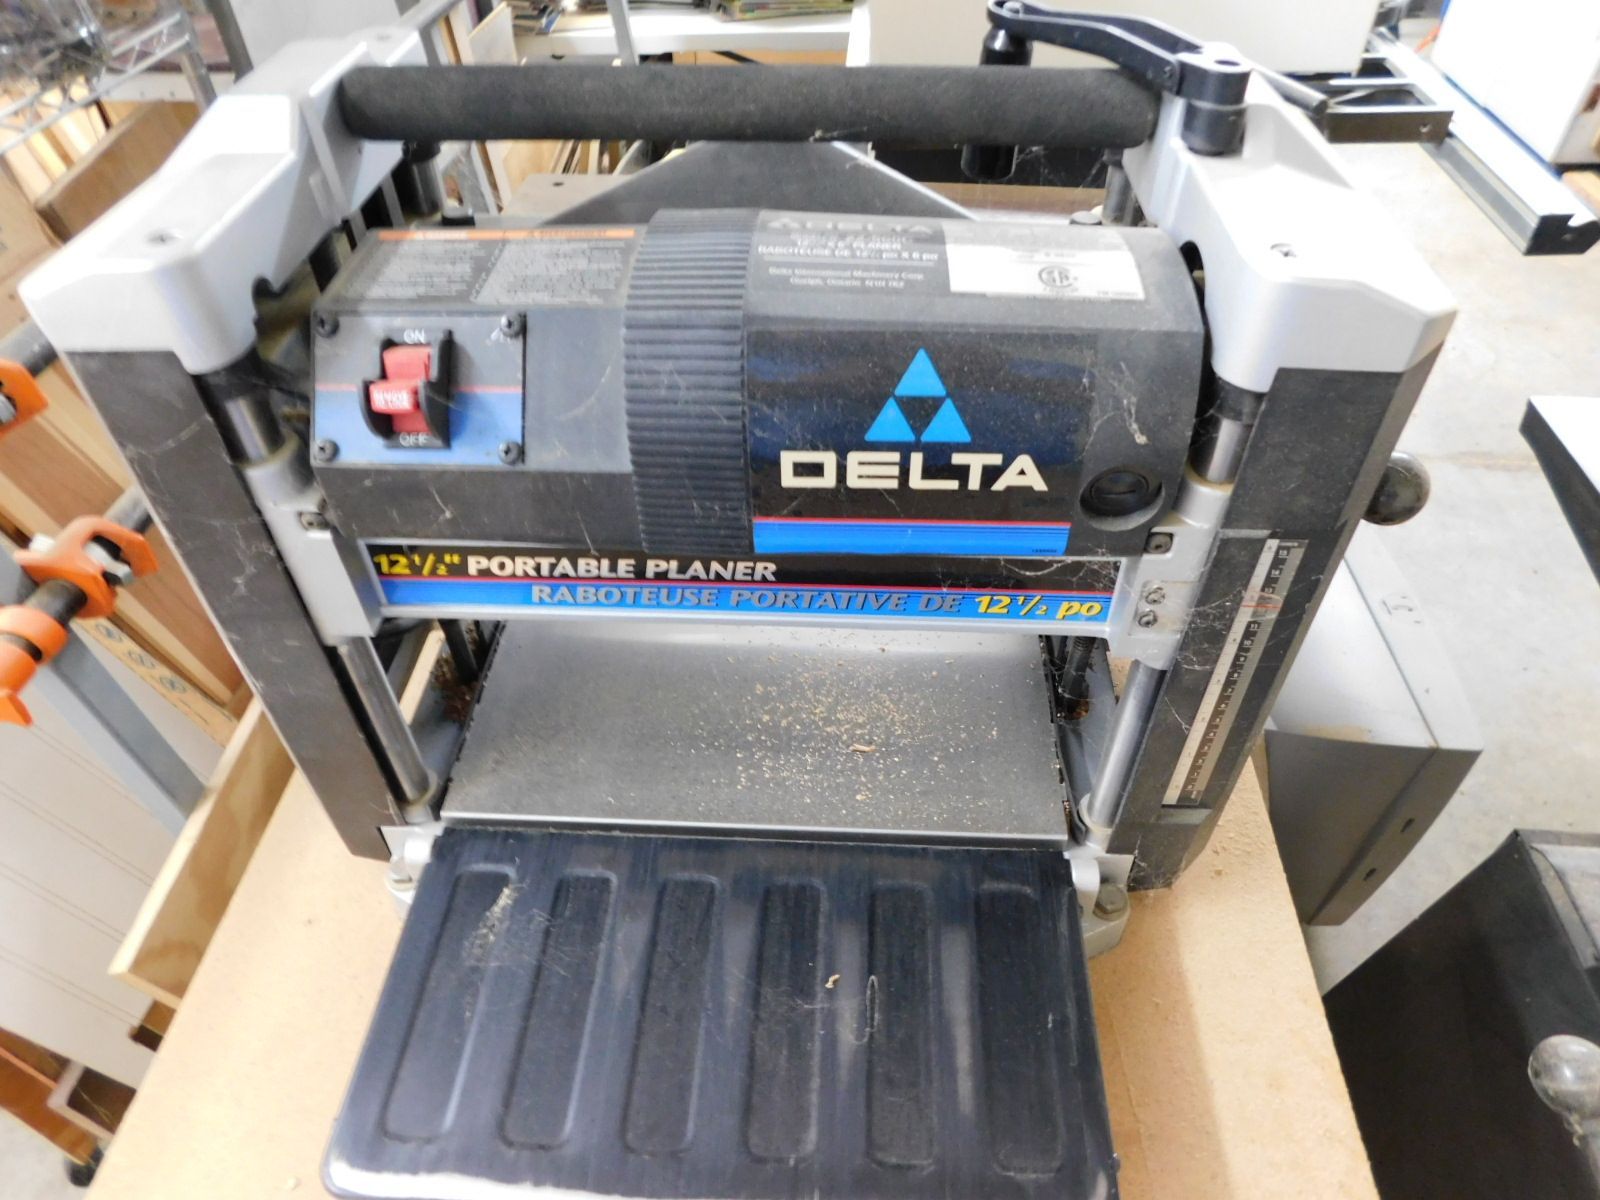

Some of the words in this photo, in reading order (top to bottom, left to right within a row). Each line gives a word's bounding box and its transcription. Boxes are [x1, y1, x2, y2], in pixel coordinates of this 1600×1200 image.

[403, 328, 426, 344] ON
[400, 432, 429, 447] OFF
[780, 450, 1049, 492] DELTA
[467, 555, 636, 579] PORTABLE
[644, 559, 778, 581] PLANER
[531, 584, 719, 608] RABOTEUSE
[730, 589, 908, 612] PORTATIVE
[918, 595, 962, 614] DE
[1056, 601, 1104, 621] po
